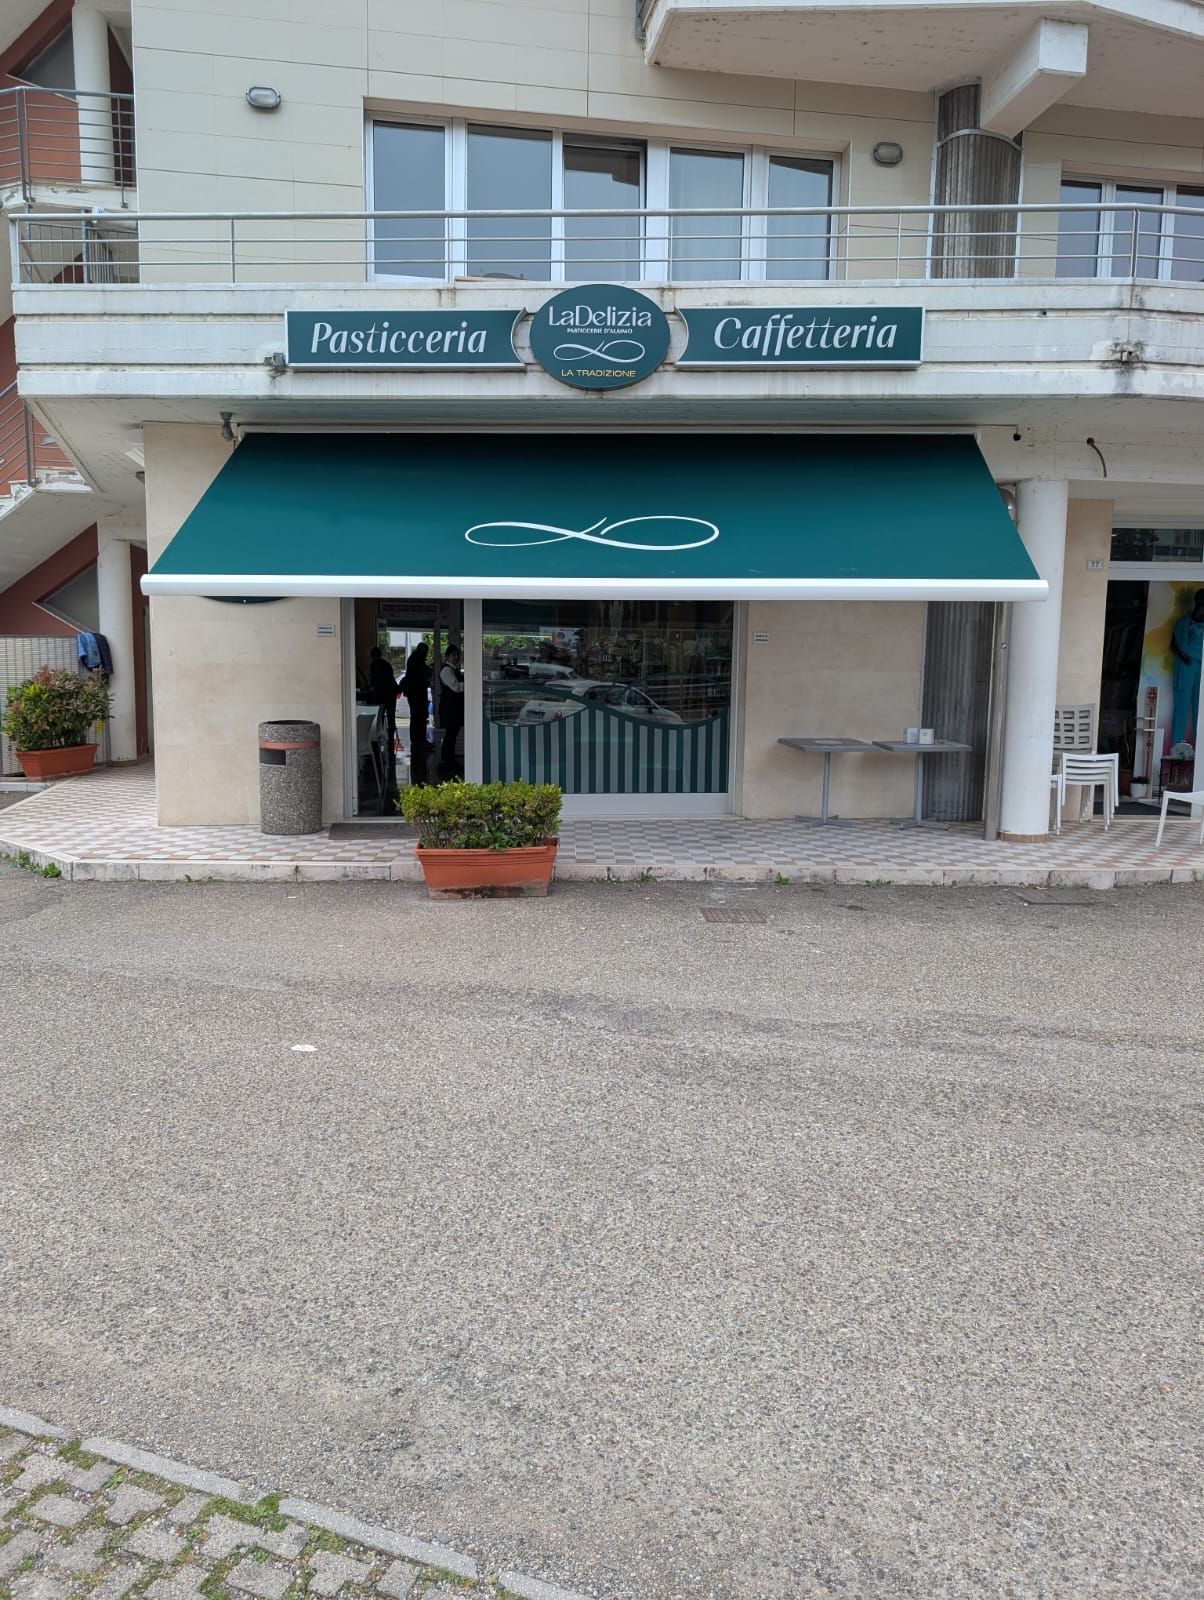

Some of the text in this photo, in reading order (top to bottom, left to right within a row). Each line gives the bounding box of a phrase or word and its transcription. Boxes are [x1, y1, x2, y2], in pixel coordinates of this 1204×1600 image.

[311, 321, 487, 354] Pasticceria
[714, 313, 898, 356] Caffetteria
[561, 369, 637, 378] LA TRADIZIONE
